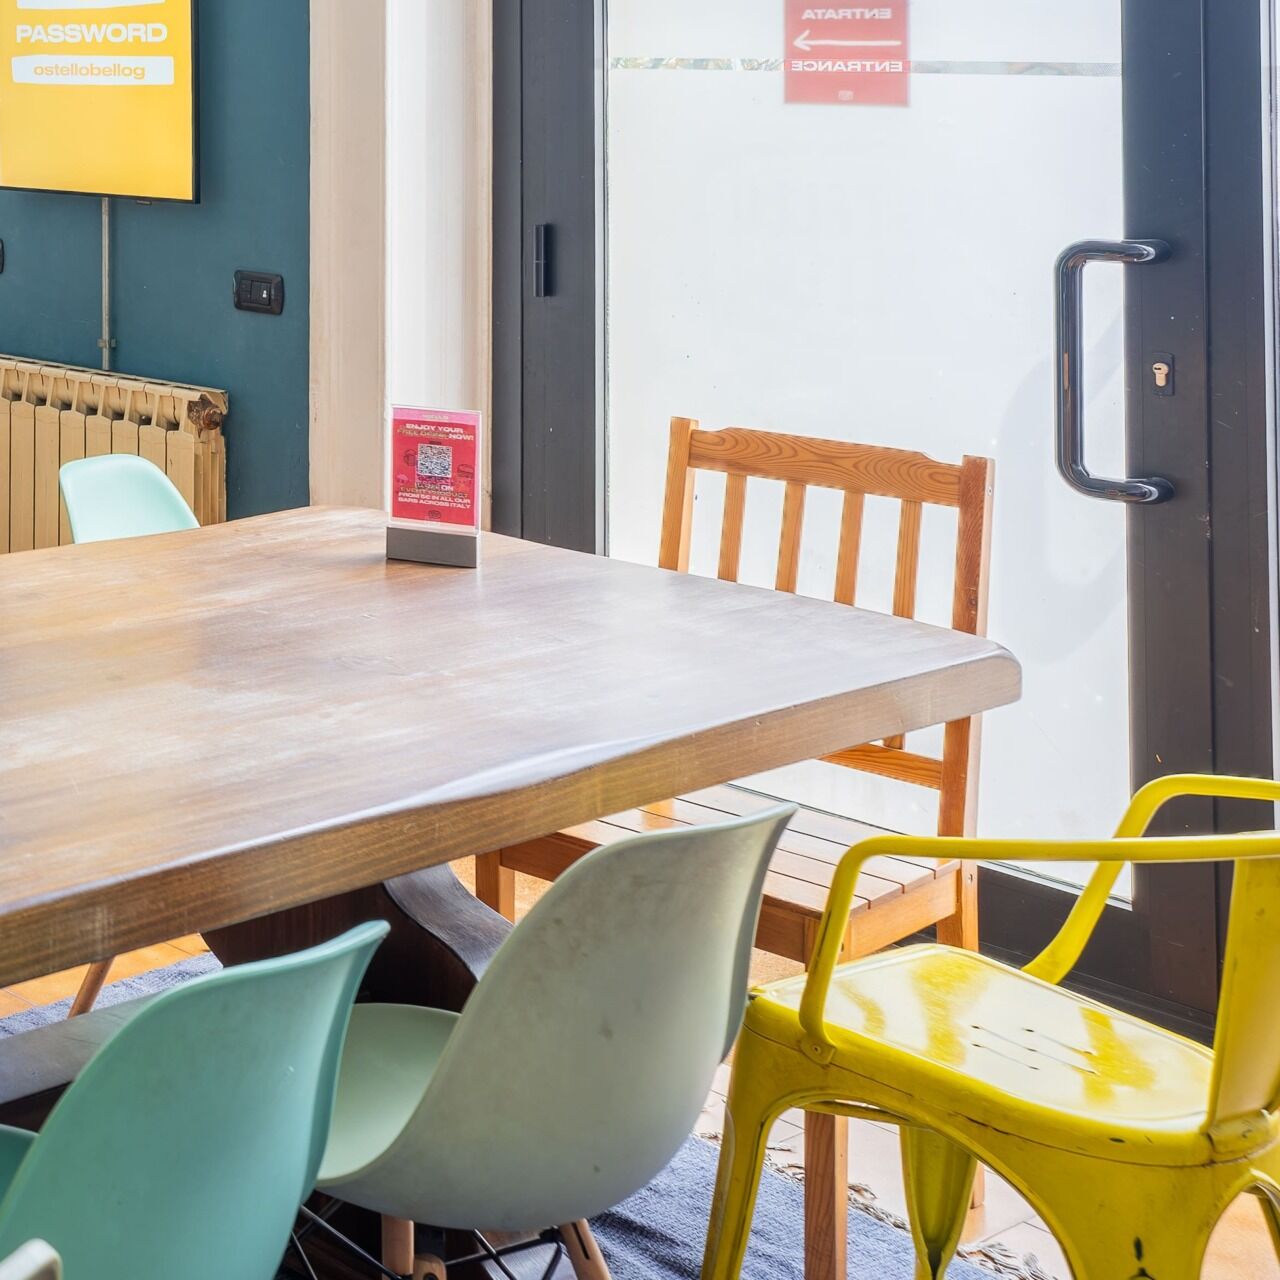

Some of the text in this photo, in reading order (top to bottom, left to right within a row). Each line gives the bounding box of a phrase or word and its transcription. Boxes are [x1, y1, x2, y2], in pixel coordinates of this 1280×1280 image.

[16, 23, 168, 44] PASSWORD
[33, 64, 146, 80] ostellobellog
[438, 425, 464, 434] YOUR
